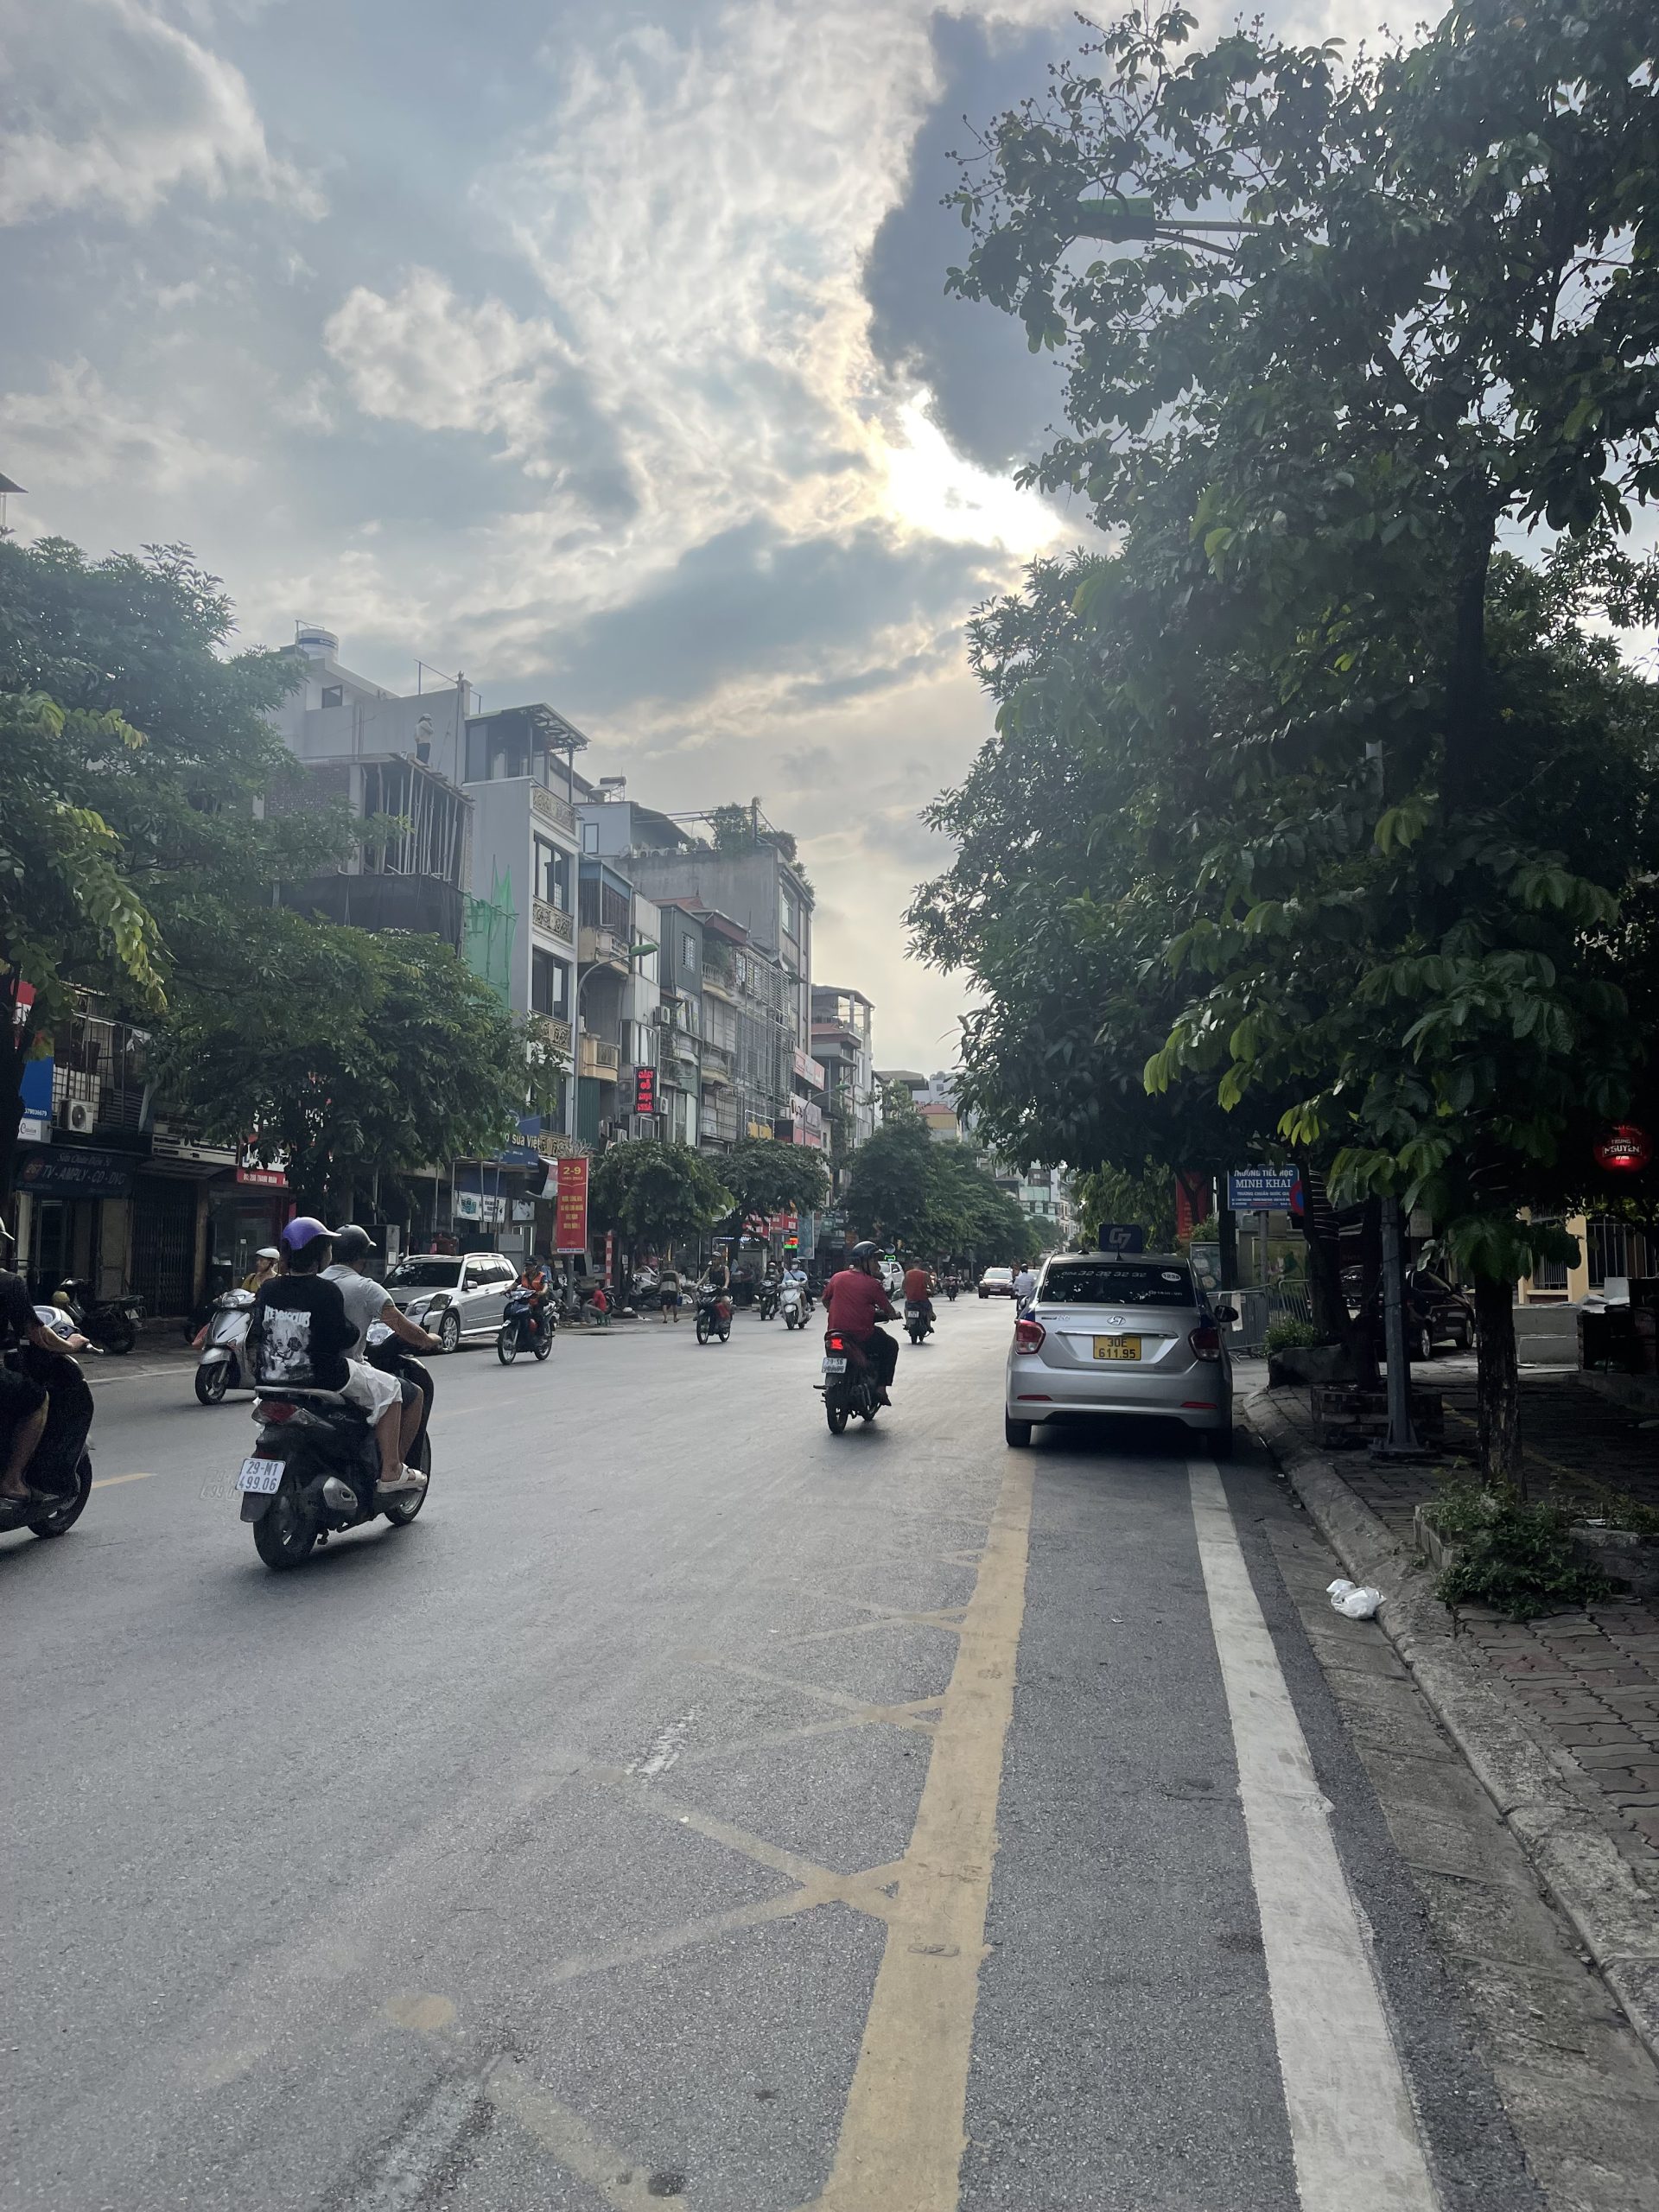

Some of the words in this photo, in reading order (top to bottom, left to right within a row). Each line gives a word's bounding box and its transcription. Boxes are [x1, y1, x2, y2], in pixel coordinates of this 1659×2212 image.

[1236, 1179, 1262, 1188] MINH
[1265, 1179, 1291, 1188] KHAI
[1109, 1227, 1132, 1249] G7
[1107, 1338, 1127, 1347] 30E
[1098, 1348, 1136, 1359] 611.95
[246, 1461, 278, 1476] 29-M1
[239, 1476, 277, 1491] 499.06
